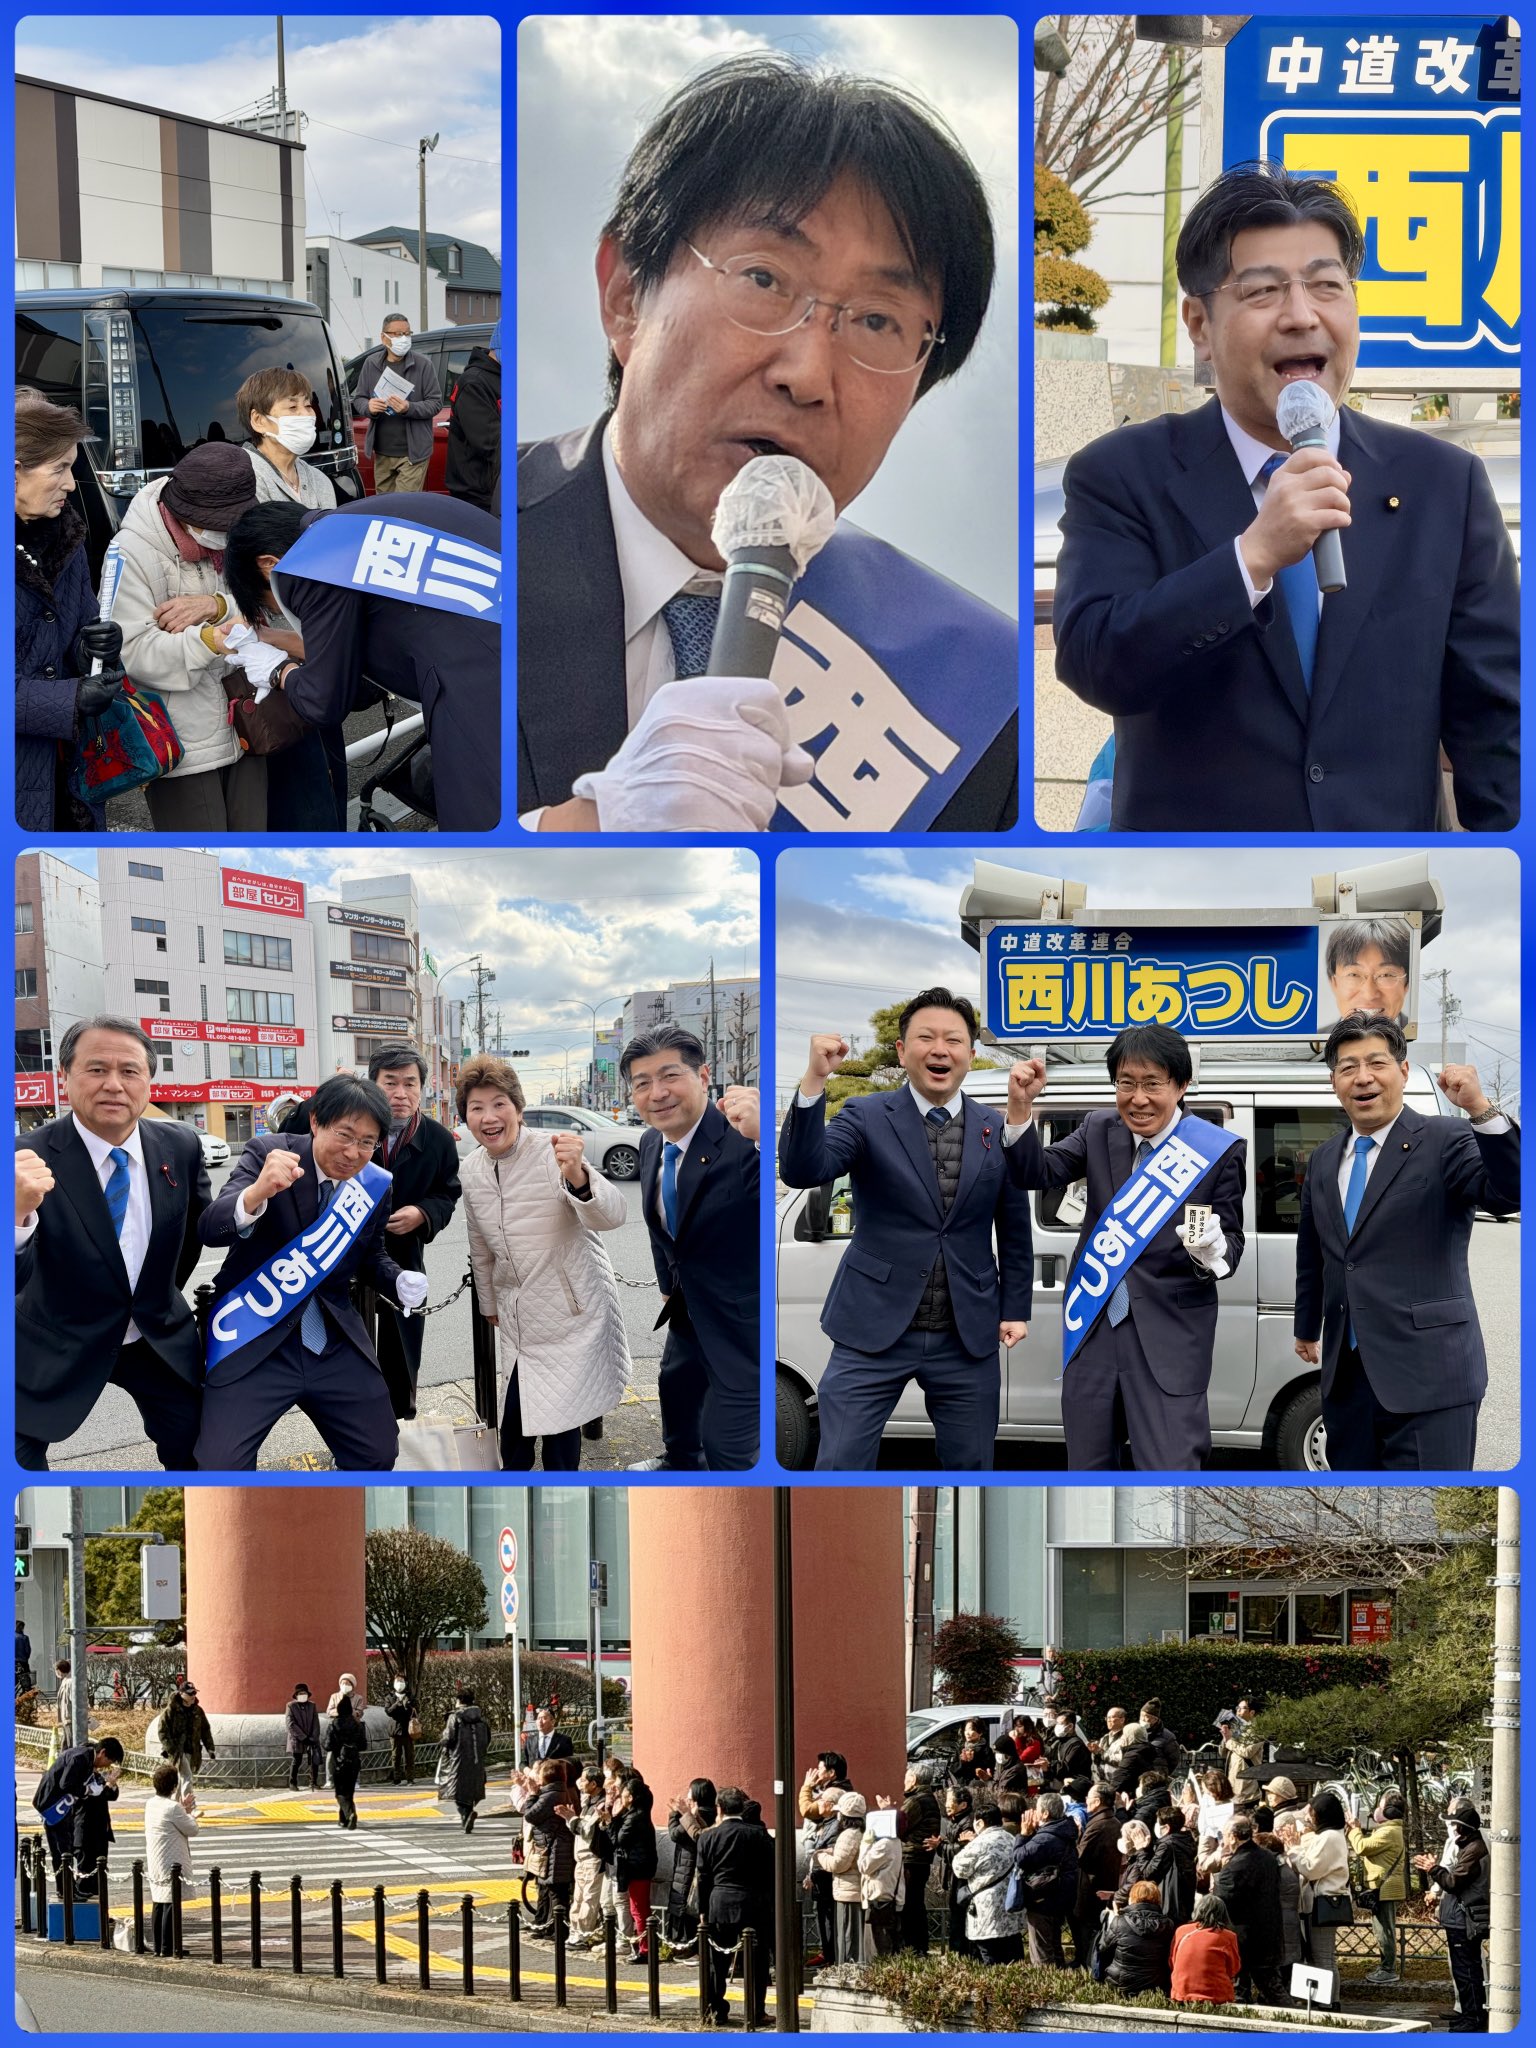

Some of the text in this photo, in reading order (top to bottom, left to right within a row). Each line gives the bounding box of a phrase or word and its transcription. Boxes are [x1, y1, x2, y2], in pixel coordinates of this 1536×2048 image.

[768, 599, 961, 832] 西
[232, 885, 297, 908] 部屋セレブ
[344, 912, 405, 929] マンガ・インターネットカフェ
[1000, 932, 1133, 951] 中道改革連合
[1005, 960, 1306, 1025] 西川あつし
[1064, 1134, 1210, 1332] 西川あつし
[1188, 1209, 1197, 1244] 西川あつし
[211, 1177, 375, 1342] 西川あつし
